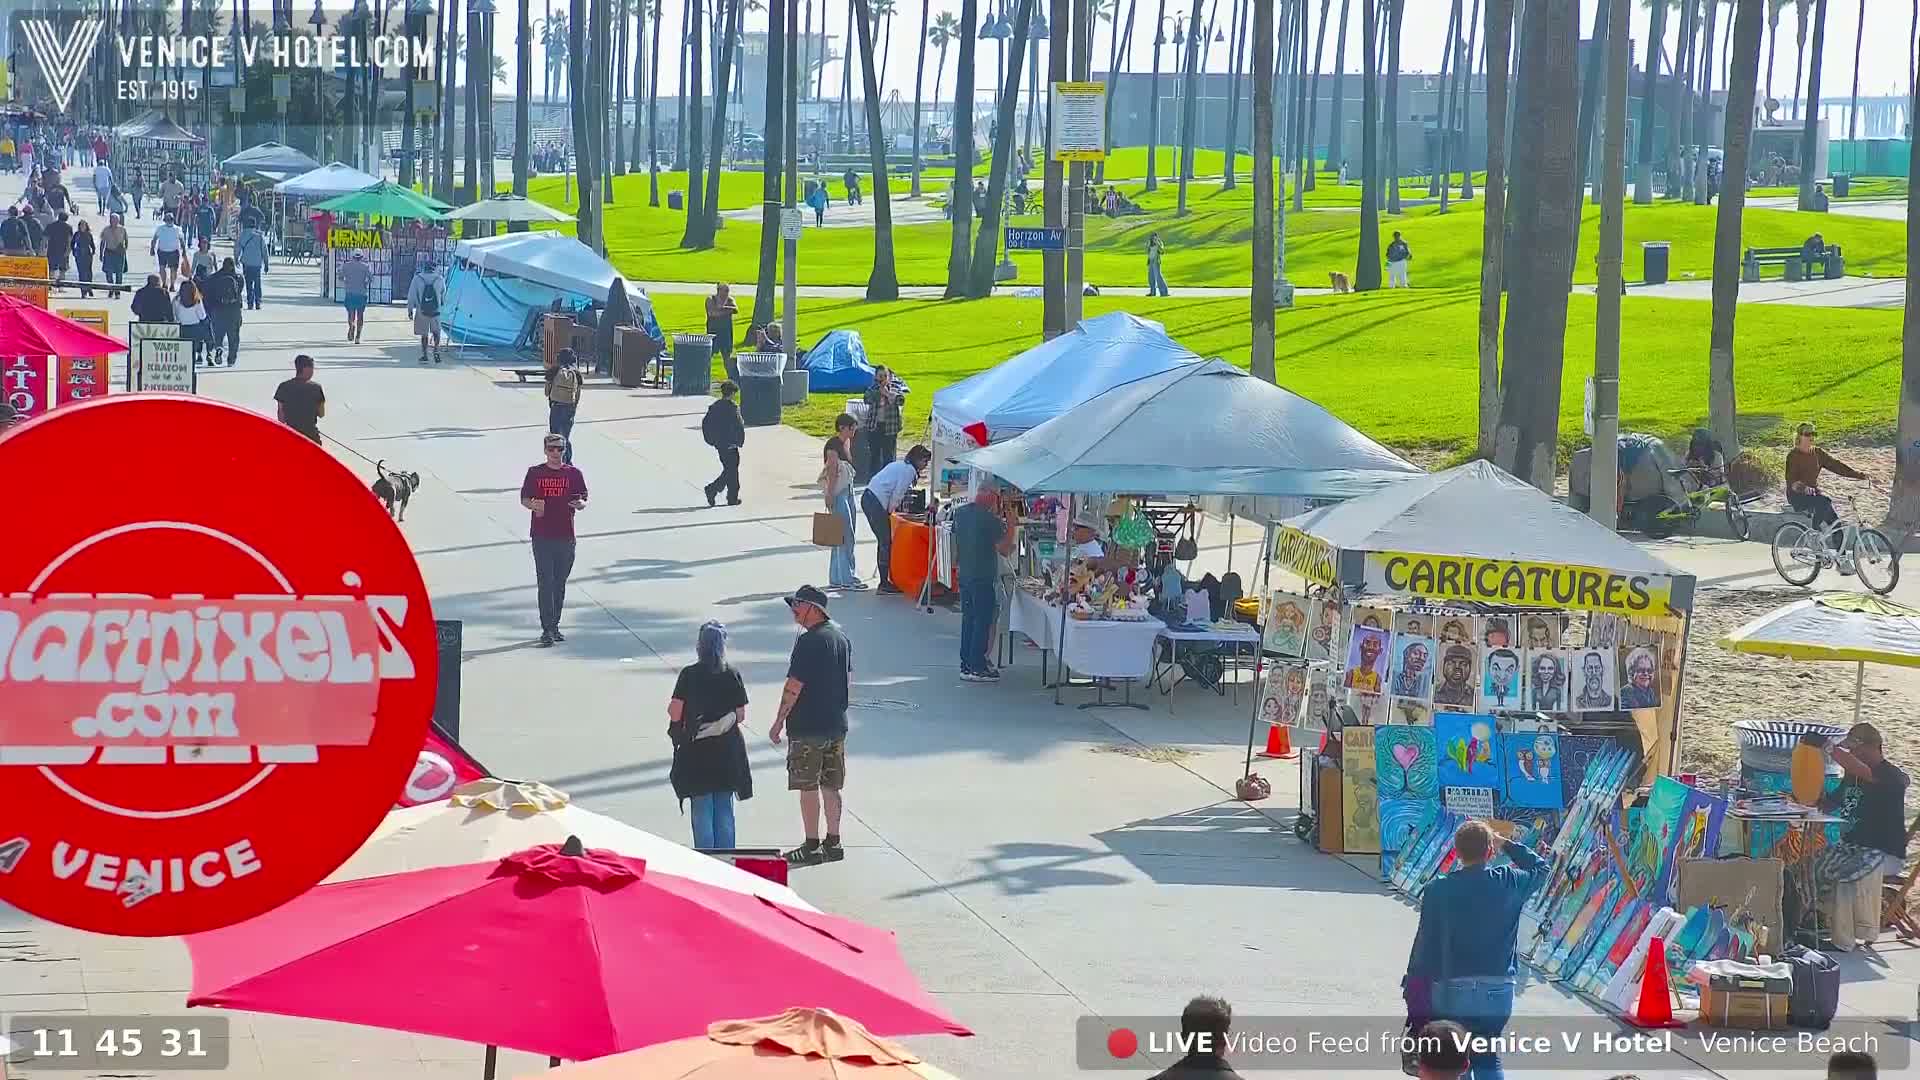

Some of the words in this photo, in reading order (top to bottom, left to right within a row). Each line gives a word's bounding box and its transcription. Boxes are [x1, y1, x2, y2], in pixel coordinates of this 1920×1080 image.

[328, 229, 382, 248] HENNA
[1008, 229, 1044, 241] Horizon
[1051, 230, 1062, 241] Av
[152, 341, 180, 352] VAPE
[147, 363, 188, 373] KRATOM
[5, 355, 37, 424] ITO
[536, 477, 570, 488] VIRGINIA
[543, 487, 563, 497] TECH
[1385, 556, 1650, 610] CARICATURES
[52, 838, 262, 894] VENICE
